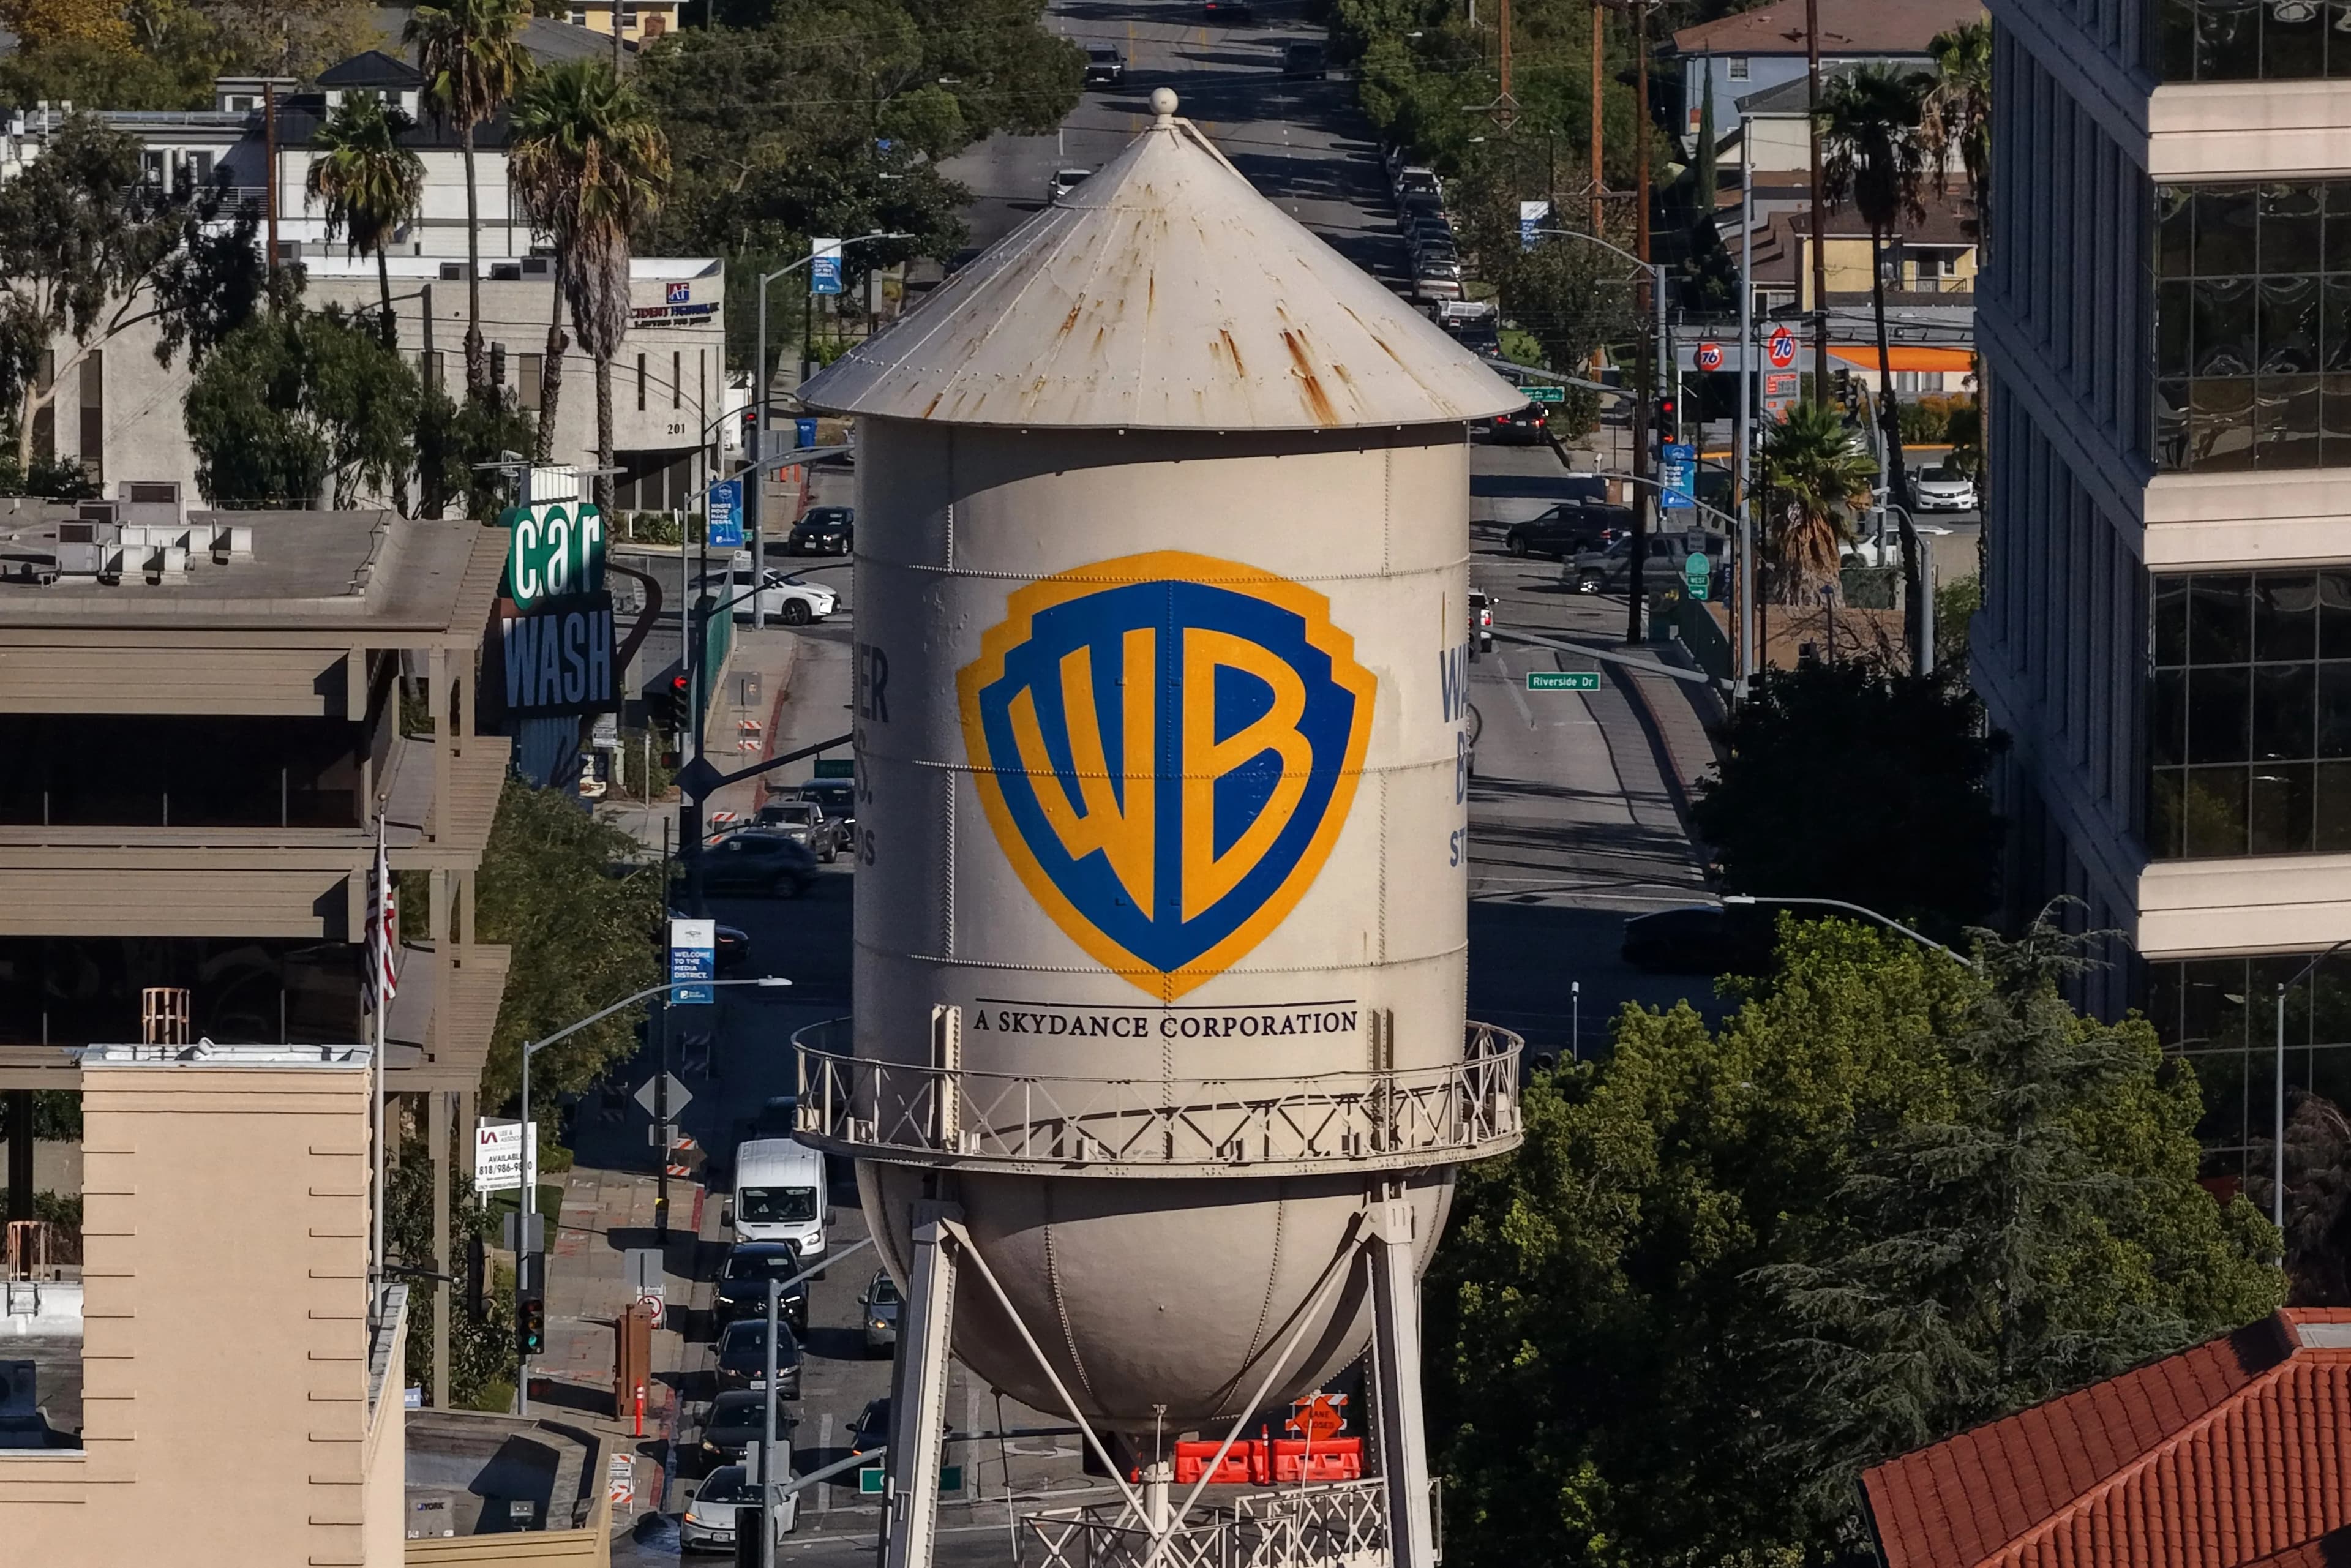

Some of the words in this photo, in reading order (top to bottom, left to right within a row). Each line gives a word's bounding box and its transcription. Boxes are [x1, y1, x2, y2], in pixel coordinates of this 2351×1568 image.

[1702, 350, 1719, 364] 76
[1772, 334, 1793, 358] 76
[667, 423, 685, 435] 201
[515, 513, 600, 600] car
[501, 609, 611, 708] WASH
[859, 643, 889, 723] ER
[1533, 677, 1577, 686] Riverside
[1582, 677, 1594, 686] Dr
[1007, 626, 1313, 925] WB
[1456, 730, 1465, 805] B
[1449, 827, 1466, 868] ST
[973, 1009, 989, 1030] A
[999, 1011, 1149, 1038] SKYDANCE
[1160, 1011, 1357, 1038] CORPORATION
[479, 1161, 533, 1176] 818/986-980
[489, 1153, 520, 1163] AVAILABL
[1302, 1420, 1335, 1429] COSED
[423, 1502, 445, 1510] YORK
